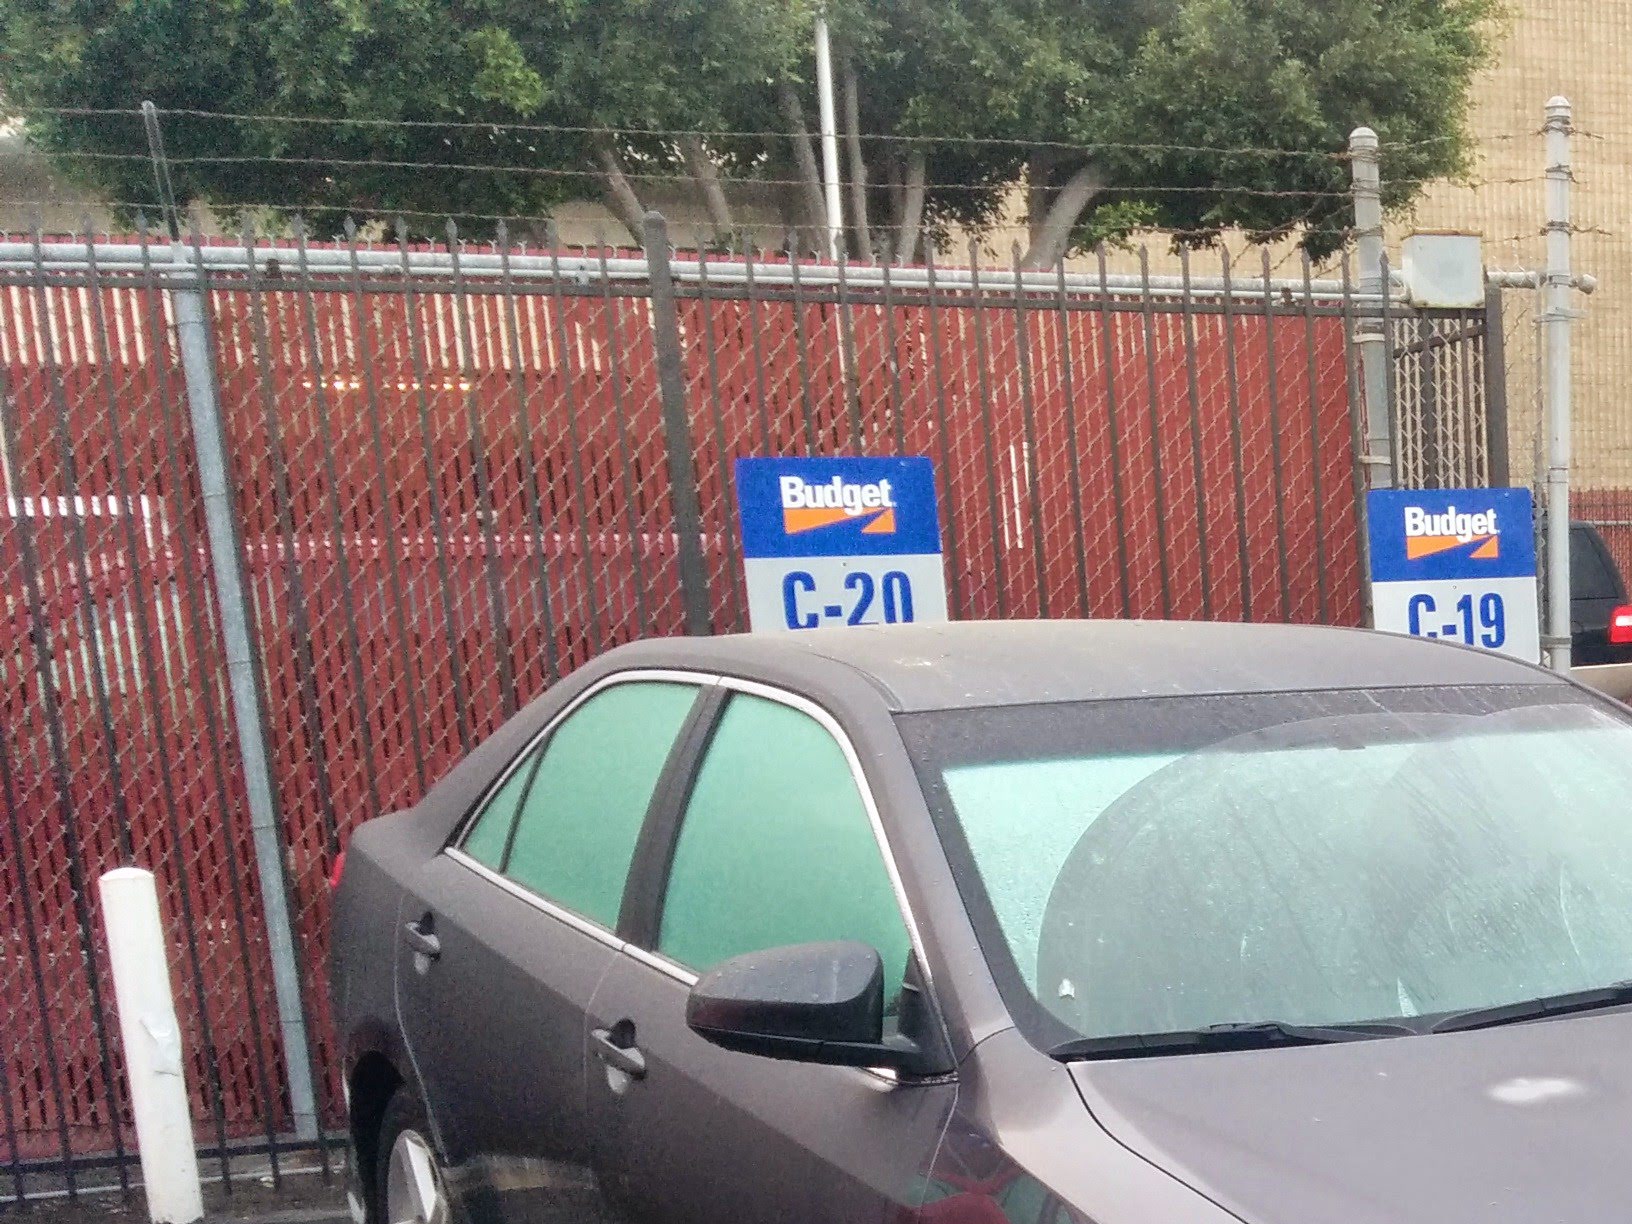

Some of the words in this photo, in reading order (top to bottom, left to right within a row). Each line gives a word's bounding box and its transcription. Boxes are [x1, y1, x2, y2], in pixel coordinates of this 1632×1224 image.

[779, 475, 895, 516] Budget
[1404, 506, 1498, 543] Budget
[782, 571, 915, 630] C-20
[1408, 592, 1506, 649] C-19
